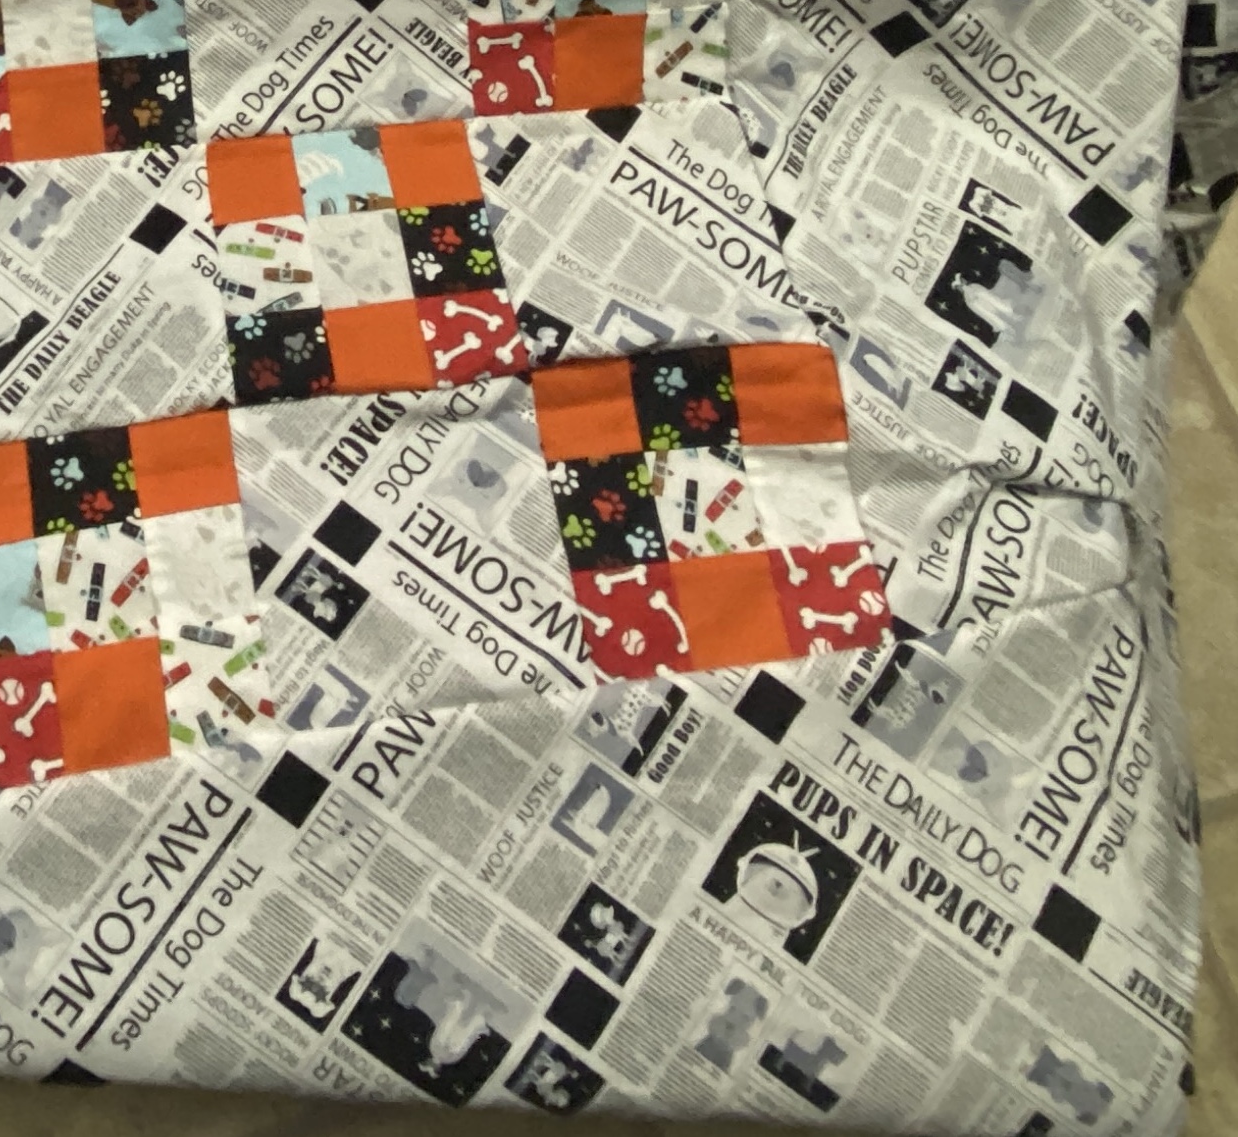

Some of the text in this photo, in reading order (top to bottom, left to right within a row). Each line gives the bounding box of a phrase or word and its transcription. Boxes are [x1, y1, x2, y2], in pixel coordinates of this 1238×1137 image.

[212, 16, 335, 140] The Dog Times
[228, 18, 269, 55] WOOF
[405, 20, 466, 70] BEAGLE
[947, 13, 1116, 167] PAW-SOME!
[923, 62, 1050, 178] The Dog Times
[665, 140, 755, 212] The Dog
[892, 201, 945, 286] PUPSTAR
[22, 326, 70, 393] DAILY
[68, 269, 122, 332] BEAGLE
[68, 280, 158, 389] ENGAGEMENT
[319, 393, 409, 487] SPACE!
[374, 393, 479, 503] DAILY DOG
[916, 542, 951, 584] The
[392, 571, 518, 682] Dog Times
[352, 711, 435, 799] PAW
[647, 709, 706, 783] Good Boy!
[1015, 626, 1137, 860] PAW-SOME!
[477, 764, 564, 884] WOOF JUSTICE
[768, 761, 1017, 956] PUPS IN SPACE!
[829, 733, 1026, 895] THE DAILY DOG
[31, 779, 234, 1039] PAW-SOME!
[210, 858, 265, 908] The
[164, 906, 225, 971] Dog
[109, 974, 184, 1052] Times
